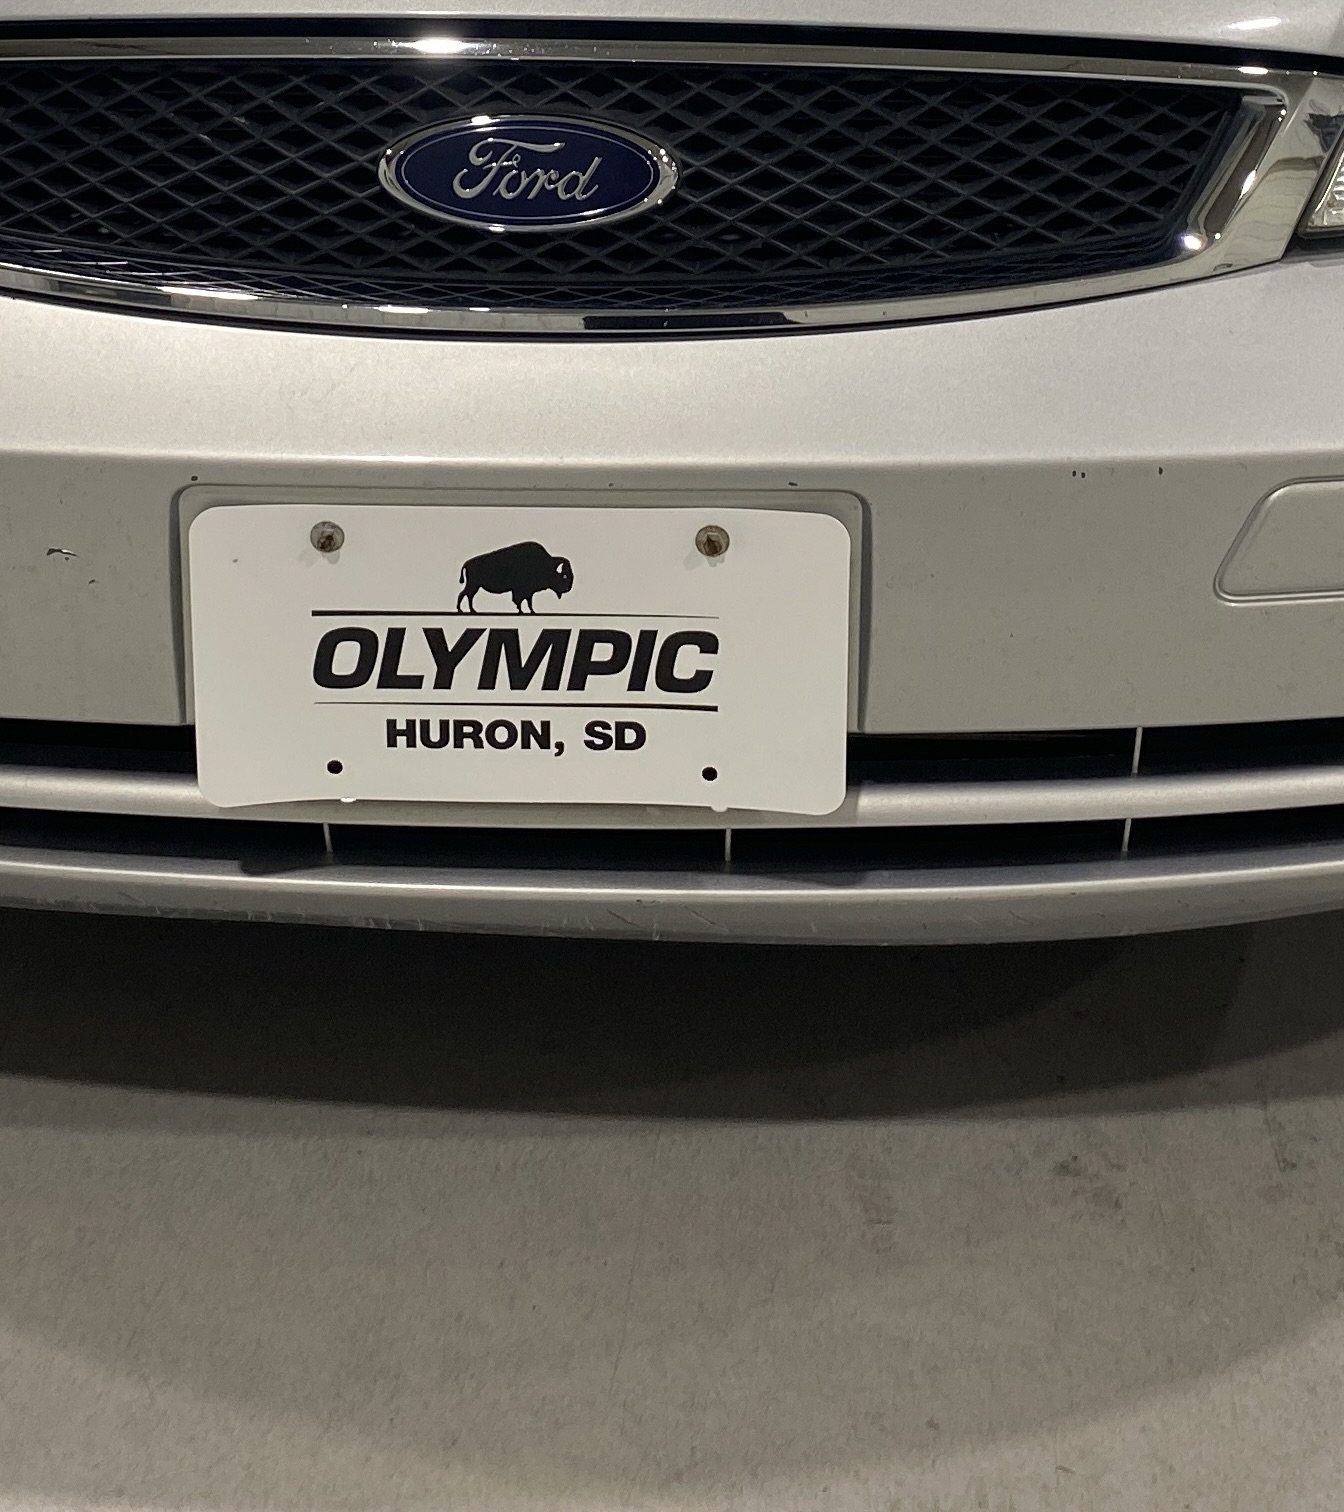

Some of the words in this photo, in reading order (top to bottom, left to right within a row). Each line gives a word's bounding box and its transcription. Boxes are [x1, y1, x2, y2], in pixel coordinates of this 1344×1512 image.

[453, 137, 603, 200] Ford
[312, 626, 720, 694] OLYMPIC
[385, 718, 566, 757] HURON,
[583, 720, 647, 751] SD
